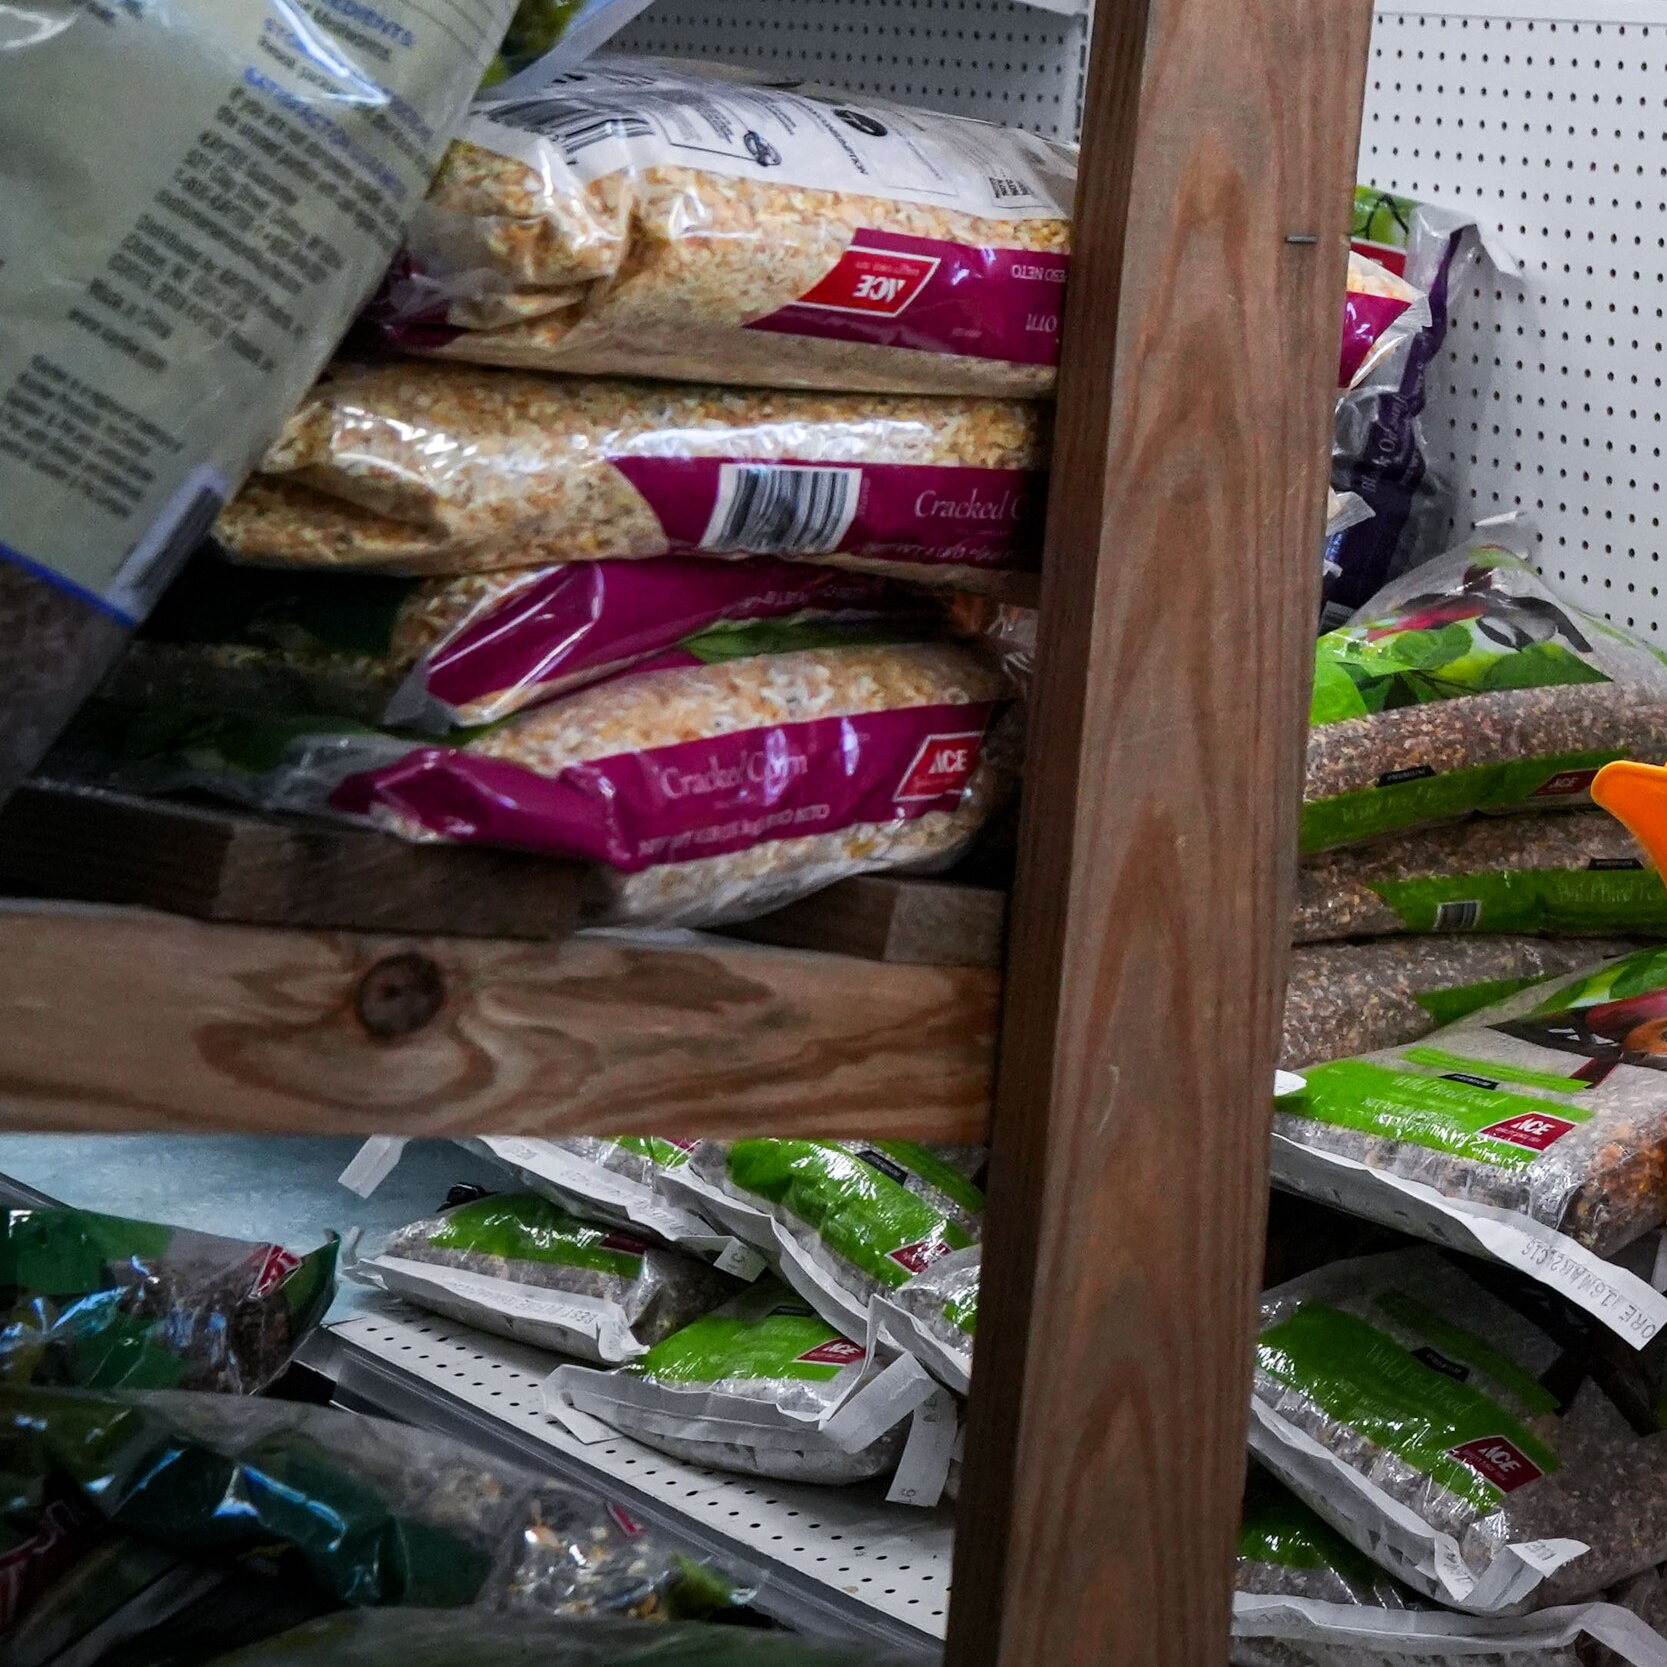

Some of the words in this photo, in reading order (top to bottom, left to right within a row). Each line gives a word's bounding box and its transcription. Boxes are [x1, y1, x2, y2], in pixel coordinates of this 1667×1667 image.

[1011, 263, 1044, 281] NETO
[852, 273, 908, 304] ACE
[913, 486, 1010, 521] Cracked
[927, 748, 970, 776] ACE
[658, 753, 746, 800] Cracked
[1550, 776, 1579, 791] ACE
[1451, 1074, 1494, 1089] PREMIUM
[1509, 1112, 1556, 1136] ACE
[824, 1341, 858, 1356] ACE
[1478, 1444, 1522, 1474] ACE
